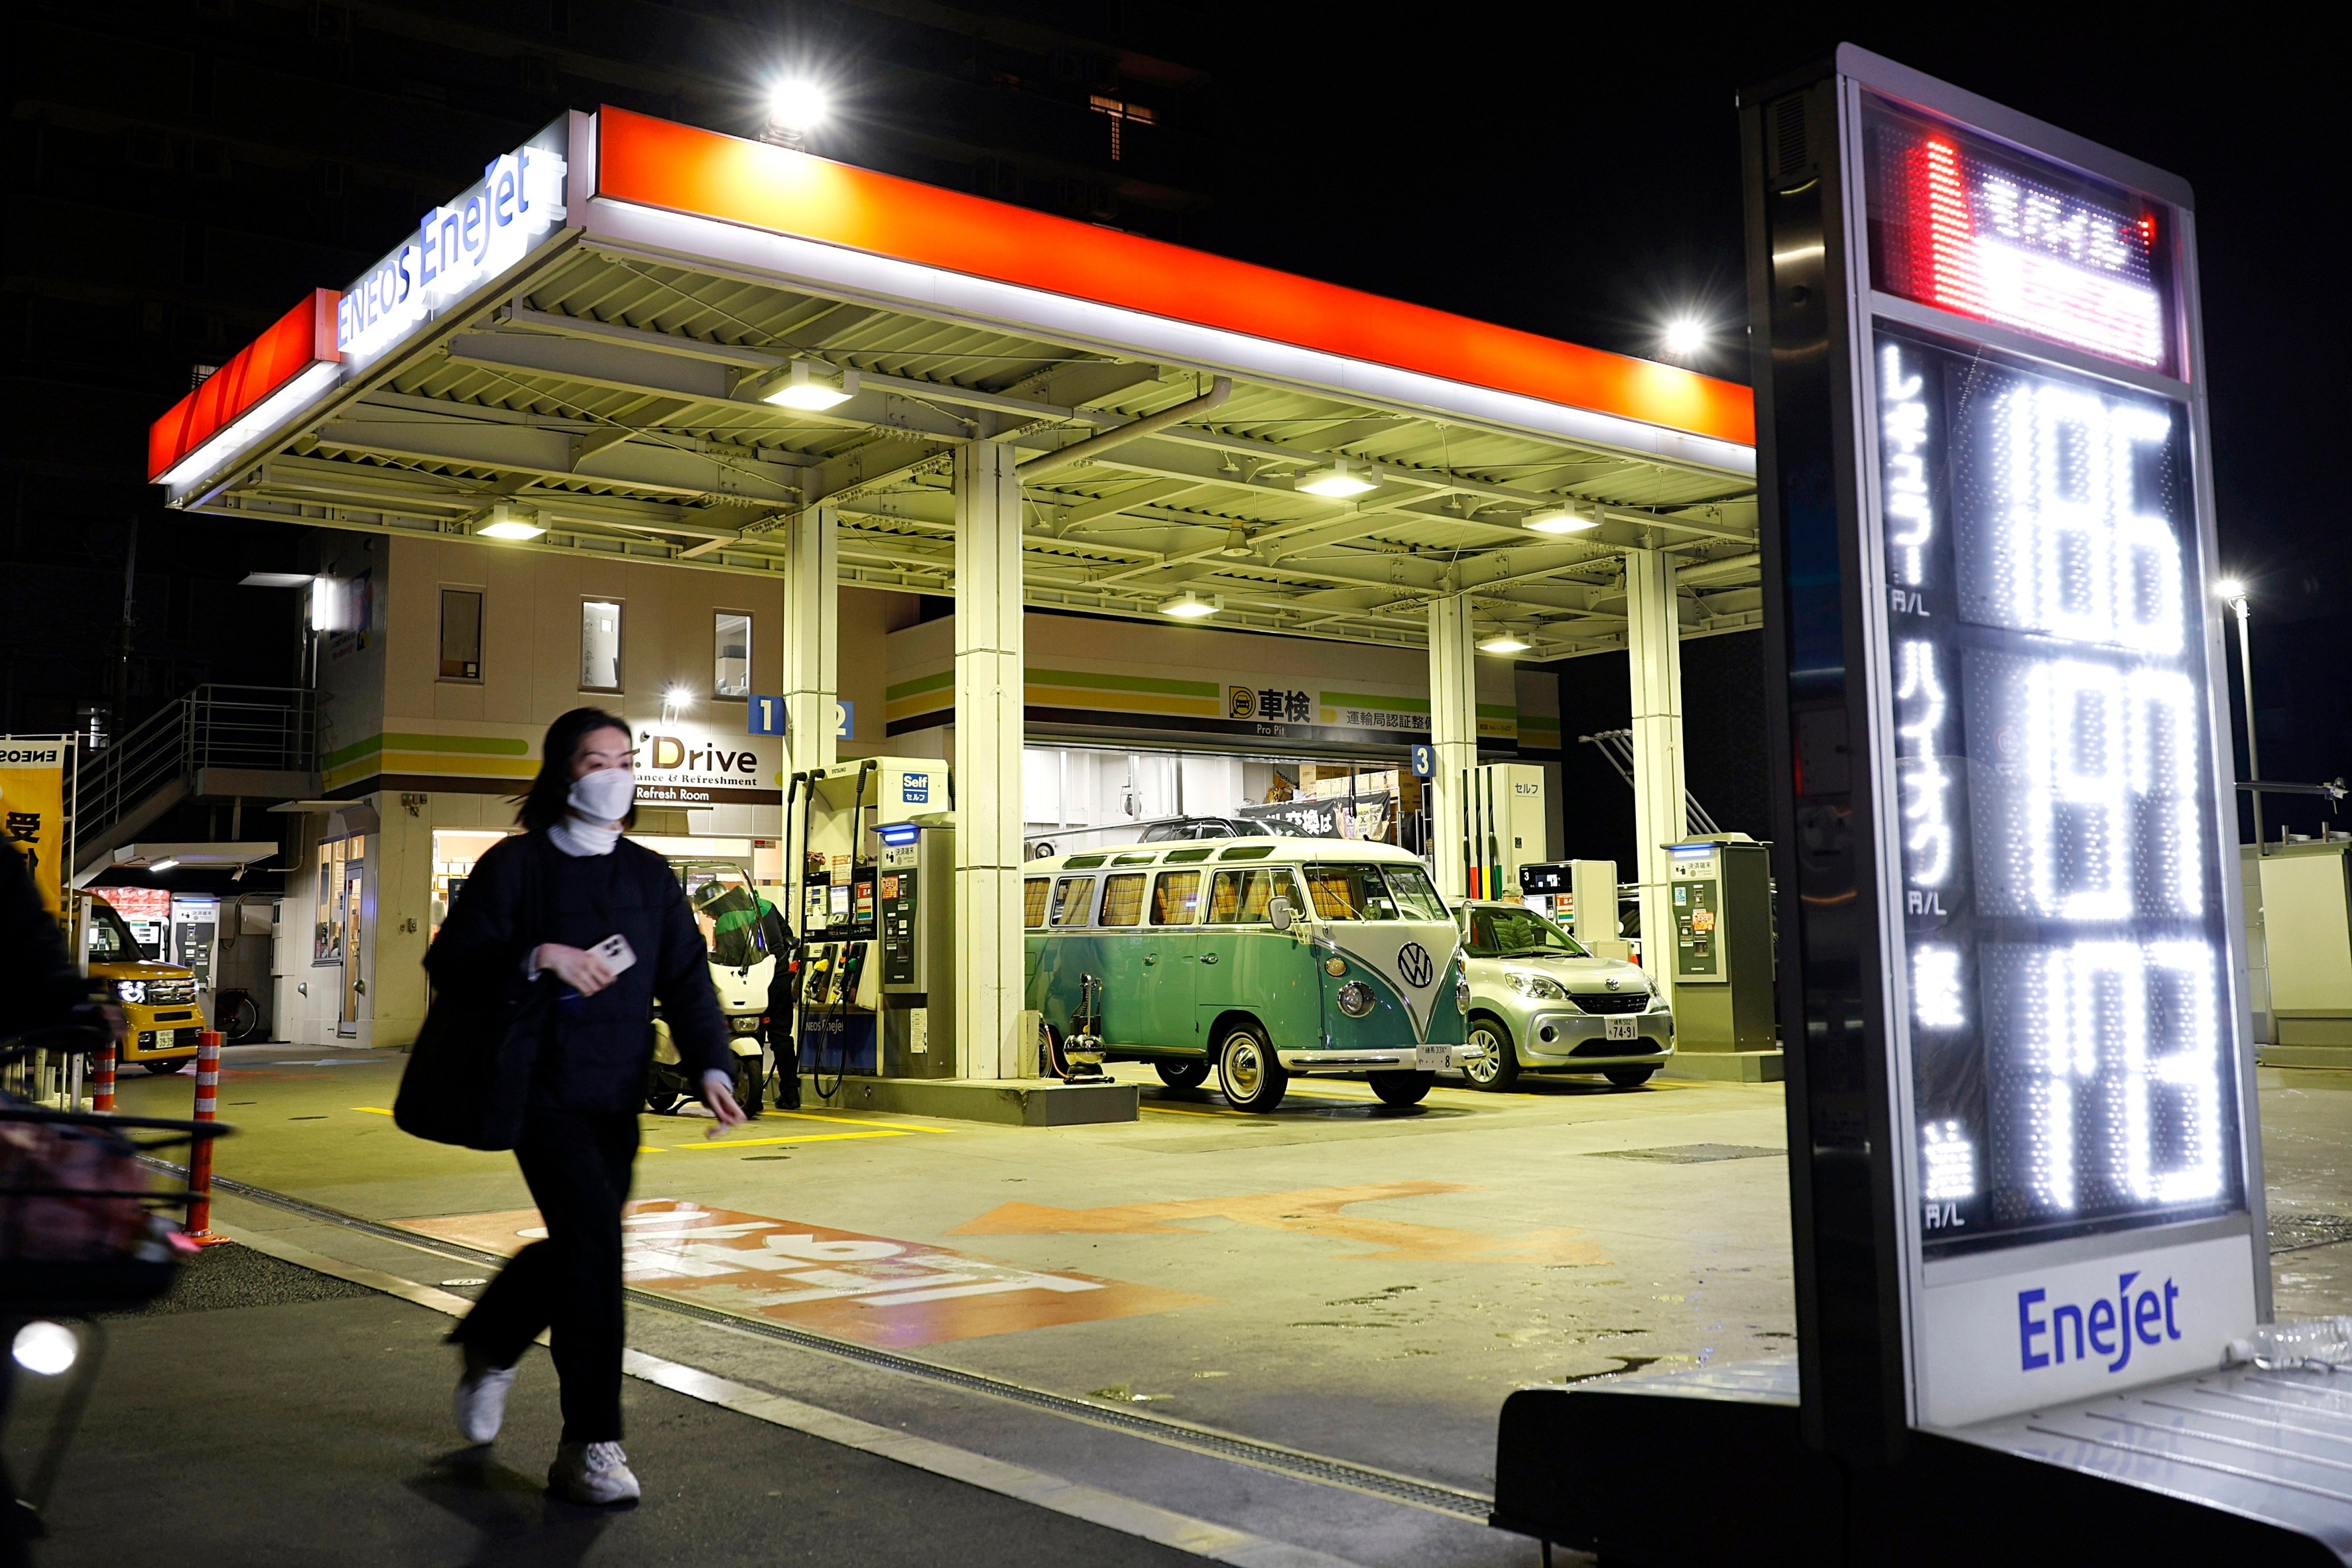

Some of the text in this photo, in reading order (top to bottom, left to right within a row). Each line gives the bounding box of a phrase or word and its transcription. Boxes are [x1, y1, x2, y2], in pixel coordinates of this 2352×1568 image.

[337, 151, 530, 351] ENEOS Enejet
[1885, 345, 1932, 585] レギュラー
[2008, 381, 2185, 655] 186
[760, 699, 771, 731] 1
[836, 704, 846, 736] 2
[1258, 689, 1311, 724] 車検
[1257, 724, 1285, 736] Pro Pit
[1416, 747, 1430, 775] 3
[1898, 640, 1951, 885] ハイオク
[636, 786, 709, 801] Refresh Room
[669, 774, 678, 782] &
[682, 775, 757, 786] Refreshment
[903, 775, 928, 788] Self
[1515, 783, 1538, 794] セルフ
[906, 793, 926, 801] セルフ
[1360, 816, 1366, 824] X
[1524, 872, 1530, 881] 3
[1907, 890, 1948, 917] 円/L
[805, 1022, 821, 1032] NEOS
[1613, 1026, 1635, 1038] 74-91
[1924, 1203, 1965, 1230] 円/L
[2018, 1270, 2181, 1373] Enejet
